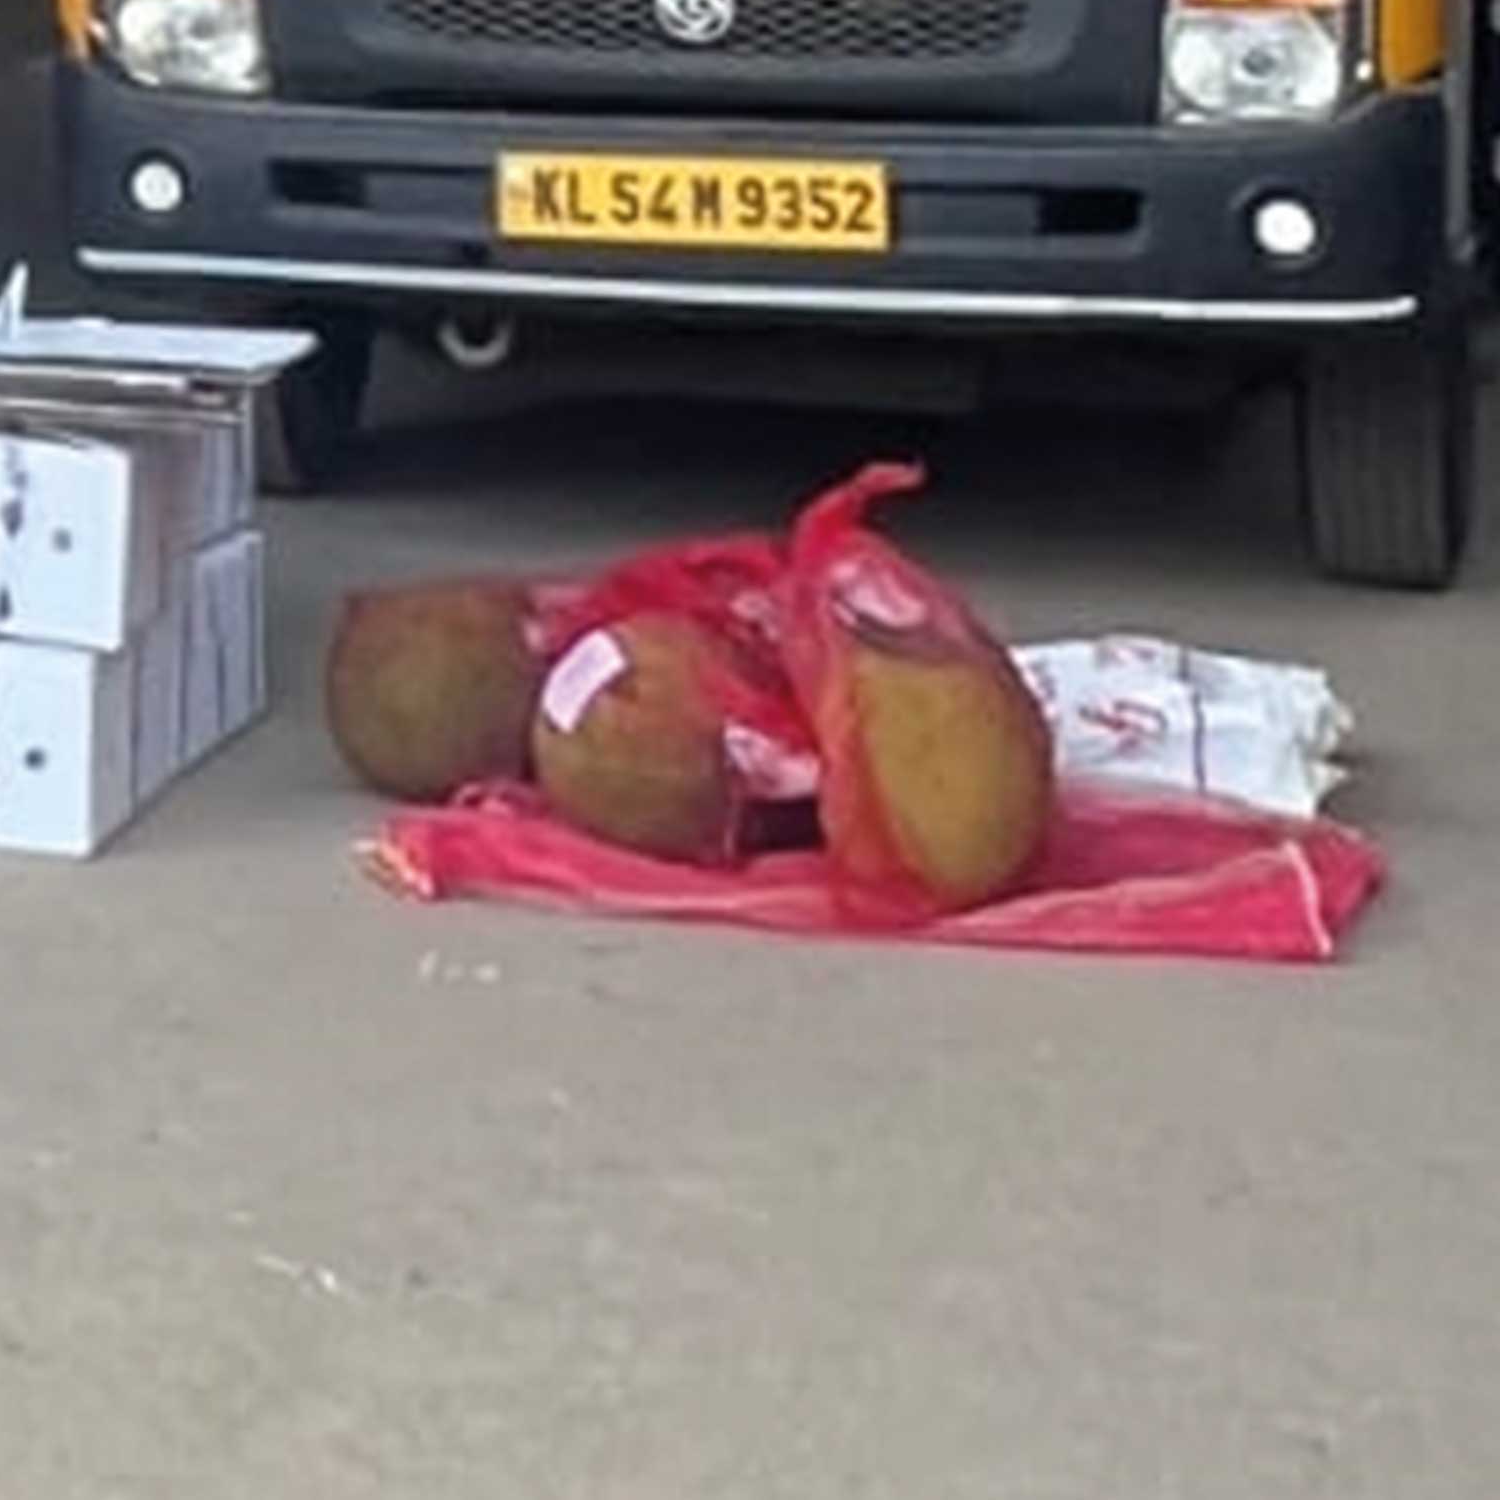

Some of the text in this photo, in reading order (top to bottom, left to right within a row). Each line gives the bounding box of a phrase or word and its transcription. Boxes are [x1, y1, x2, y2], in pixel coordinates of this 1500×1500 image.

[531, 167, 596, 224] KL
[609, 170, 680, 226] 54
[735, 177, 877, 234] 9352
